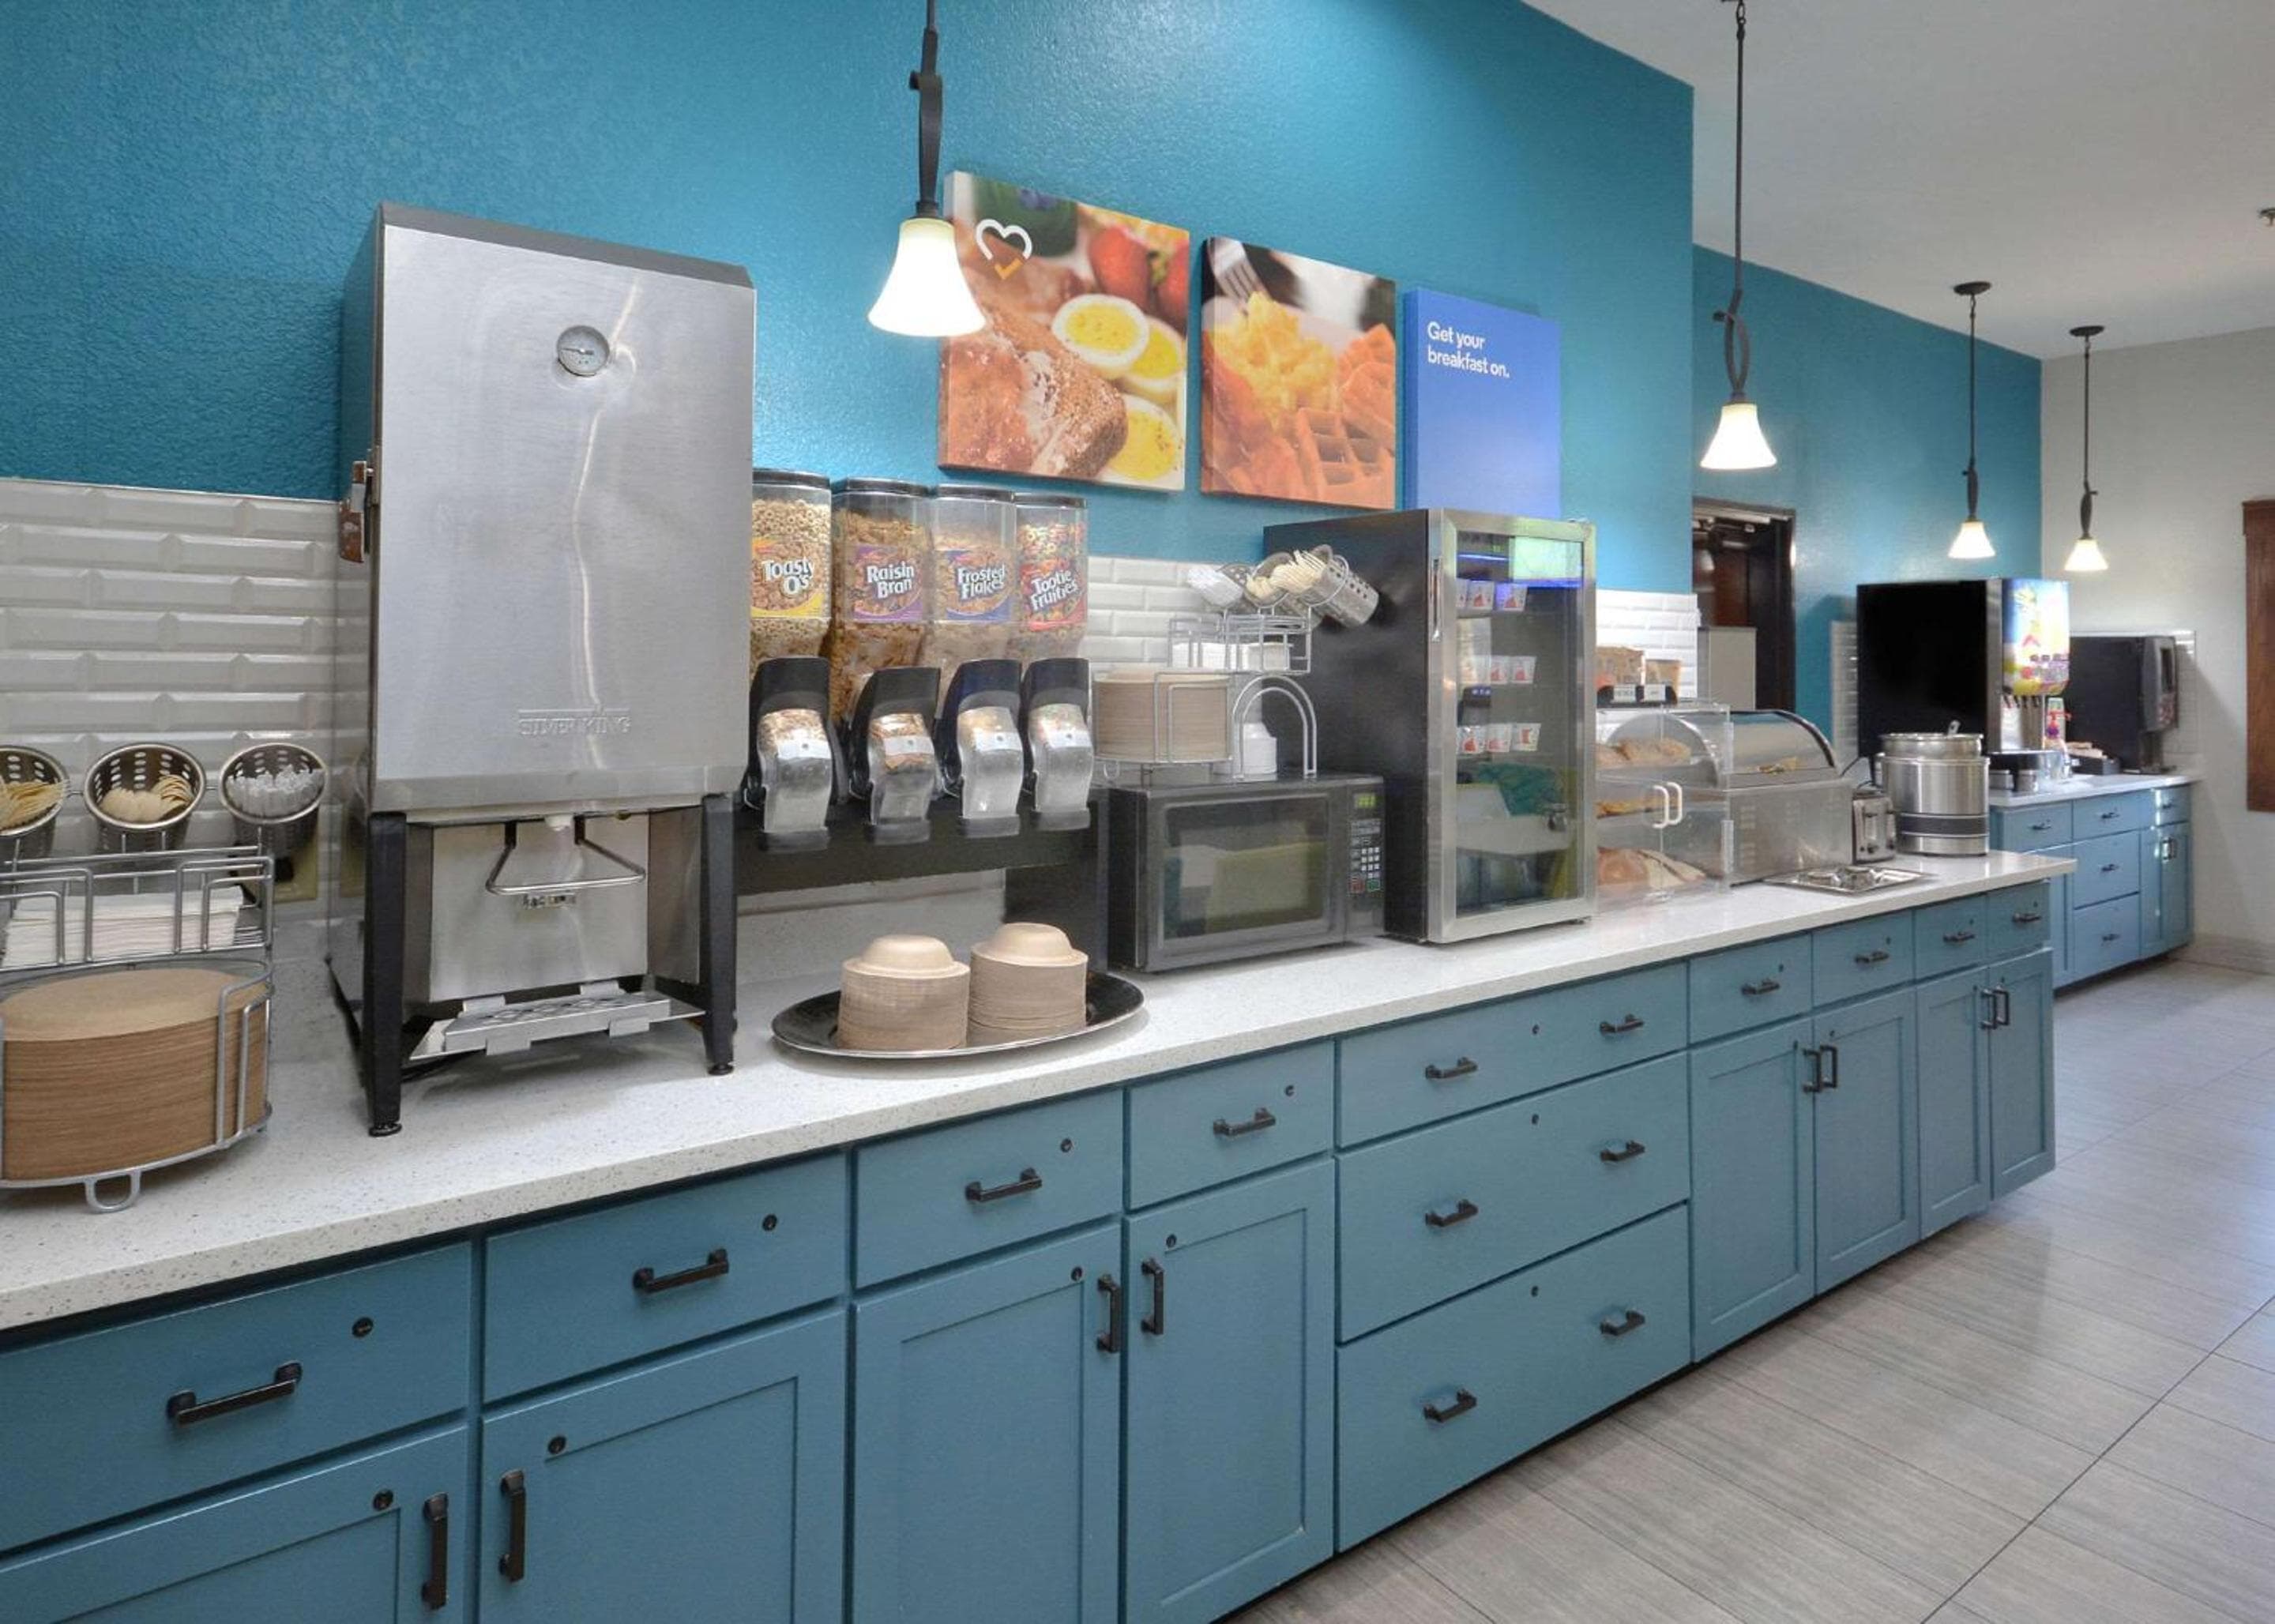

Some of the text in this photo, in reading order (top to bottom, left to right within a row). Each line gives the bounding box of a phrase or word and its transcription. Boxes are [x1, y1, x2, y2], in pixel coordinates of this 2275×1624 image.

[1427, 321, 1486, 350] Get your
[1427, 344, 1510, 378] breakfast on.
[761, 557, 815, 581] Toasty
[867, 560, 915, 583] Raisin
[957, 563, 1006, 584] Frosted
[877, 578, 912, 599] Bran
[961, 579, 1005, 600] Flakes
[1031, 570, 1073, 594] Tootie
[1030, 579, 1079, 611] Fruities
